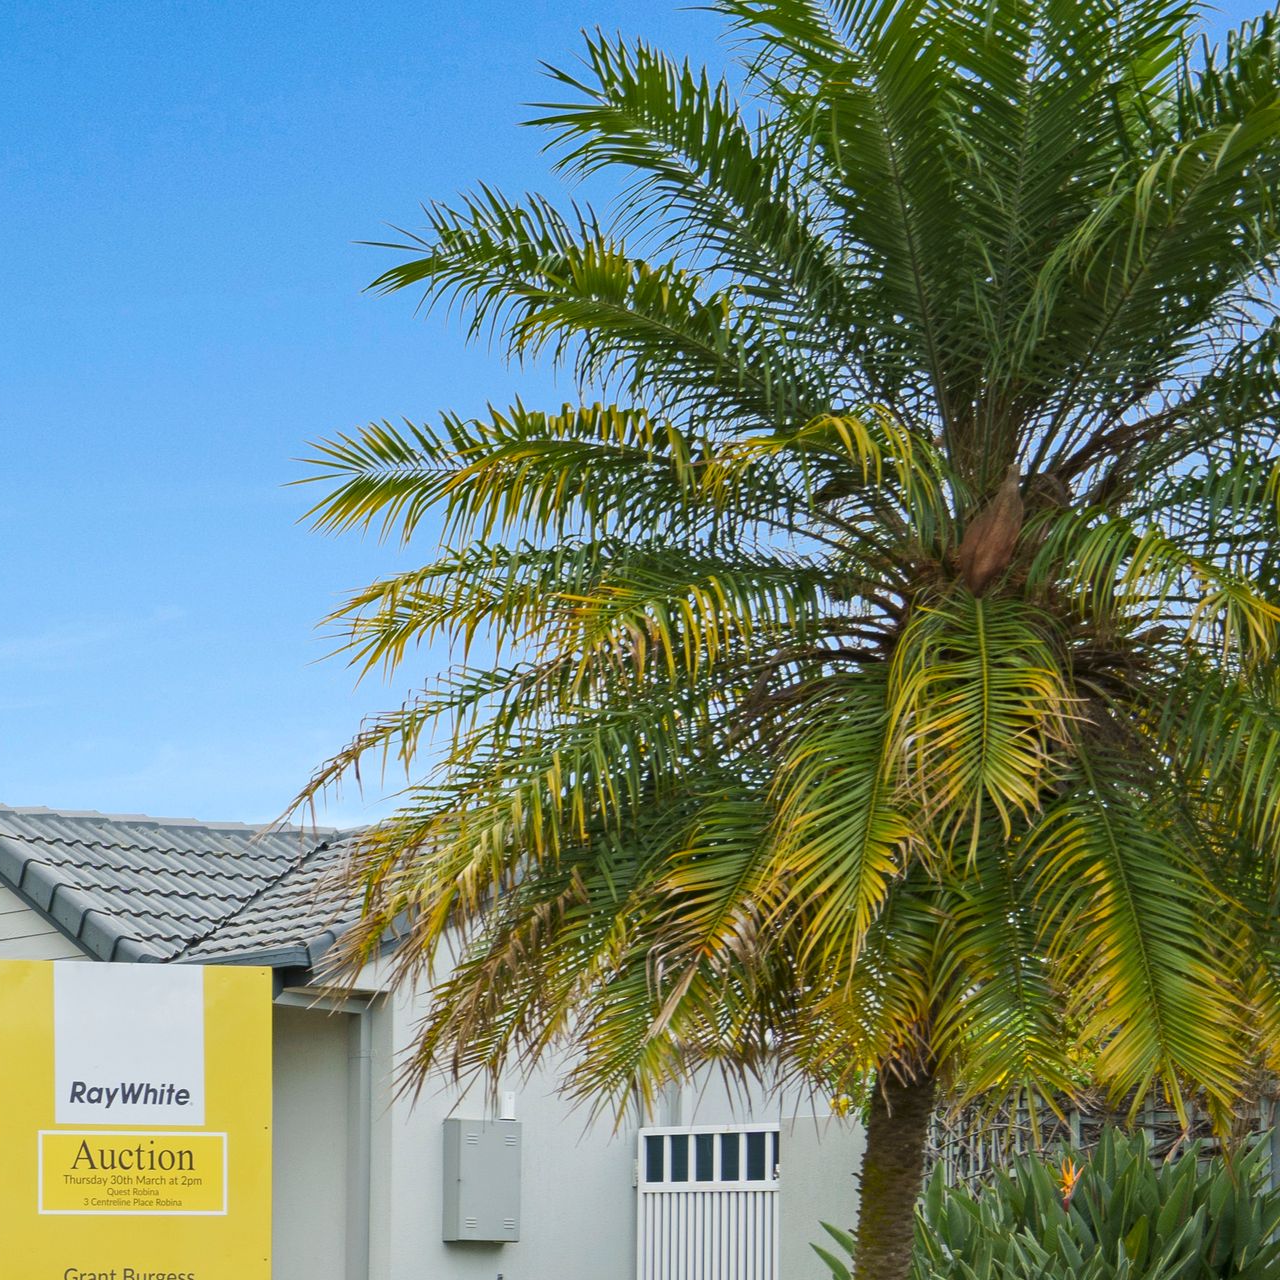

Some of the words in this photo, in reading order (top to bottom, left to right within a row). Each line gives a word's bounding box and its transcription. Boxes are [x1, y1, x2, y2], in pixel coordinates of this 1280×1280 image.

[69, 1081, 190, 1109] RayWhite
[70, 1139, 196, 1171] Auction
[63, 1175, 108, 1186] Thursday
[110, 1175, 133, 1185] 30th
[136, 1176, 166, 1185] March
[168, 1177, 179, 1185] at
[181, 1176, 202, 1187] 2pm
[107, 1187, 130, 1197] Quest
[132, 1187, 159, 1196] Robina
[83, 1198, 89, 1206] 3
[91, 1198, 131, 1206] Centreline
[133, 1198, 154, 1206] Place
[155, 1198, 182, 1207] Robina
